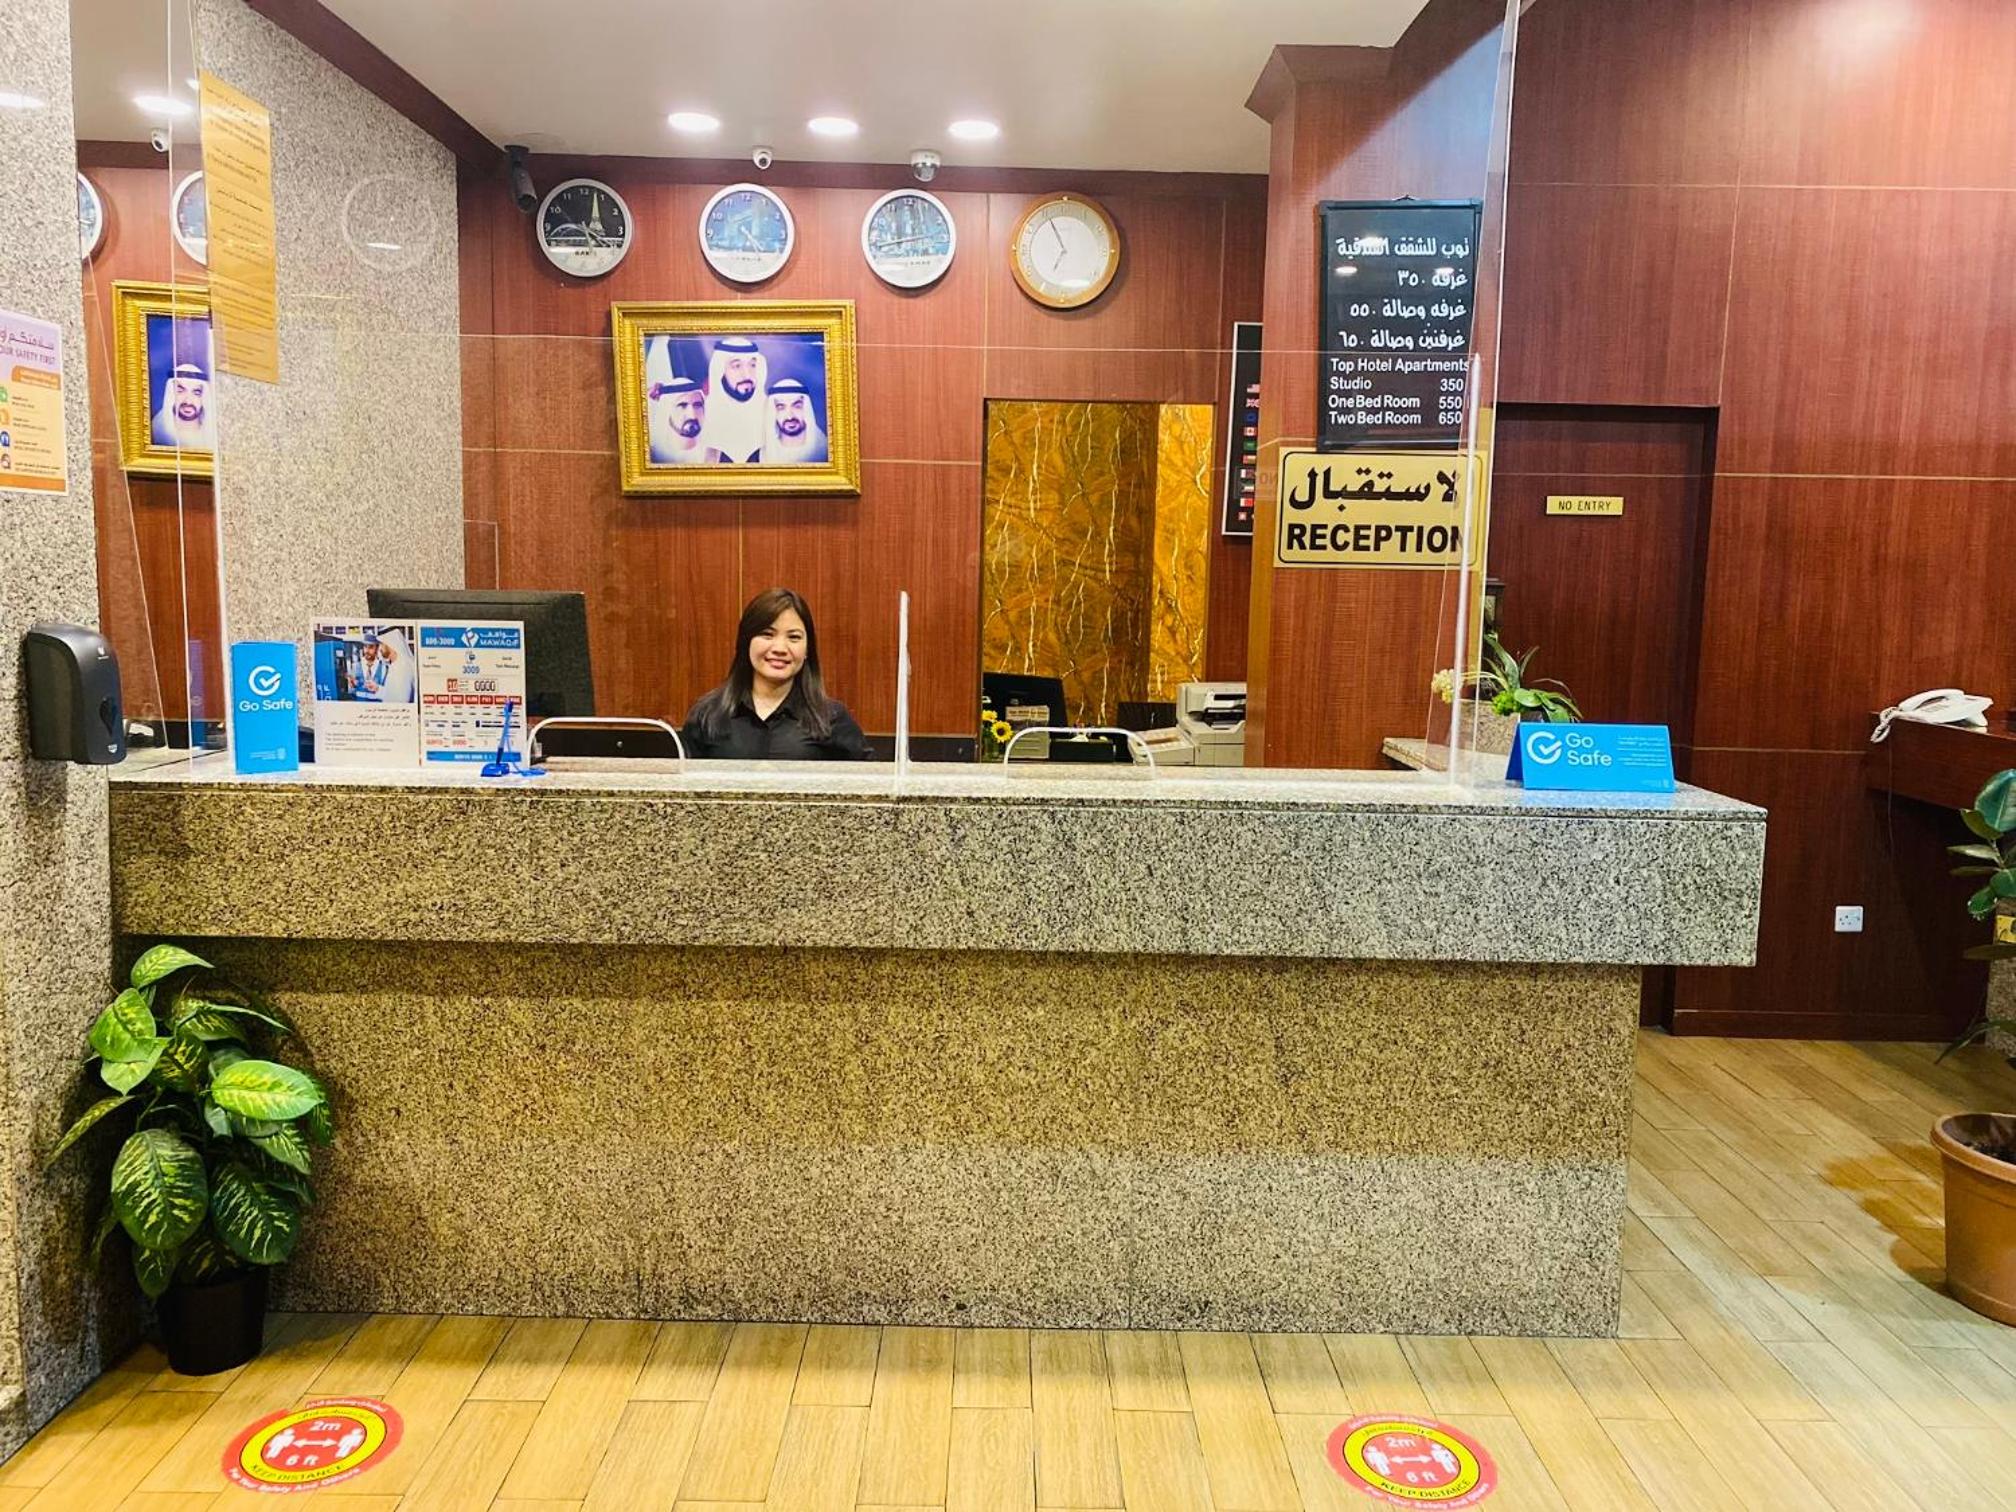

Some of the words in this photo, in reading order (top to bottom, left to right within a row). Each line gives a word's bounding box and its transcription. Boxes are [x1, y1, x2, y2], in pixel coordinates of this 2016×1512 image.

[550, 206, 561, 214] 10
[618, 227, 623, 235] 3
[1350, 304, 1376, 317] ٥٥٠
[1382, 299, 1426, 319] وصالة
[1338, 331, 1364, 347] ٦٥٠
[1370, 328, 1414, 349] وصالة
[1330, 358, 1354, 374] Top
[1357, 358, 1392, 372] Hotel
[1395, 358, 1469, 374] Apartments
[1330, 376, 1372, 390] Studio
[1440, 378, 1464, 392] 350
[1383, 396, 1420, 408] Room
[1438, 396, 1463, 409] 550
[1384, 411, 1421, 424] Room
[1438, 411, 1462, 425] 650
[1288, 466, 1458, 512] لاستقبال
[1558, 501, 1572, 511] NO
[1577, 501, 1611, 511] ENTRY
[239, 700, 259, 712] Go
[262, 698, 293, 711] Safe
[1565, 733, 1595, 748] Go
[1567, 750, 1612, 767] Safe
[310, 1421, 342, 1431] 2m
[1385, 1437, 1416, 1448] 2m
[285, 1455, 299, 1466] 6
[1406, 1471, 1418, 1483] 6
